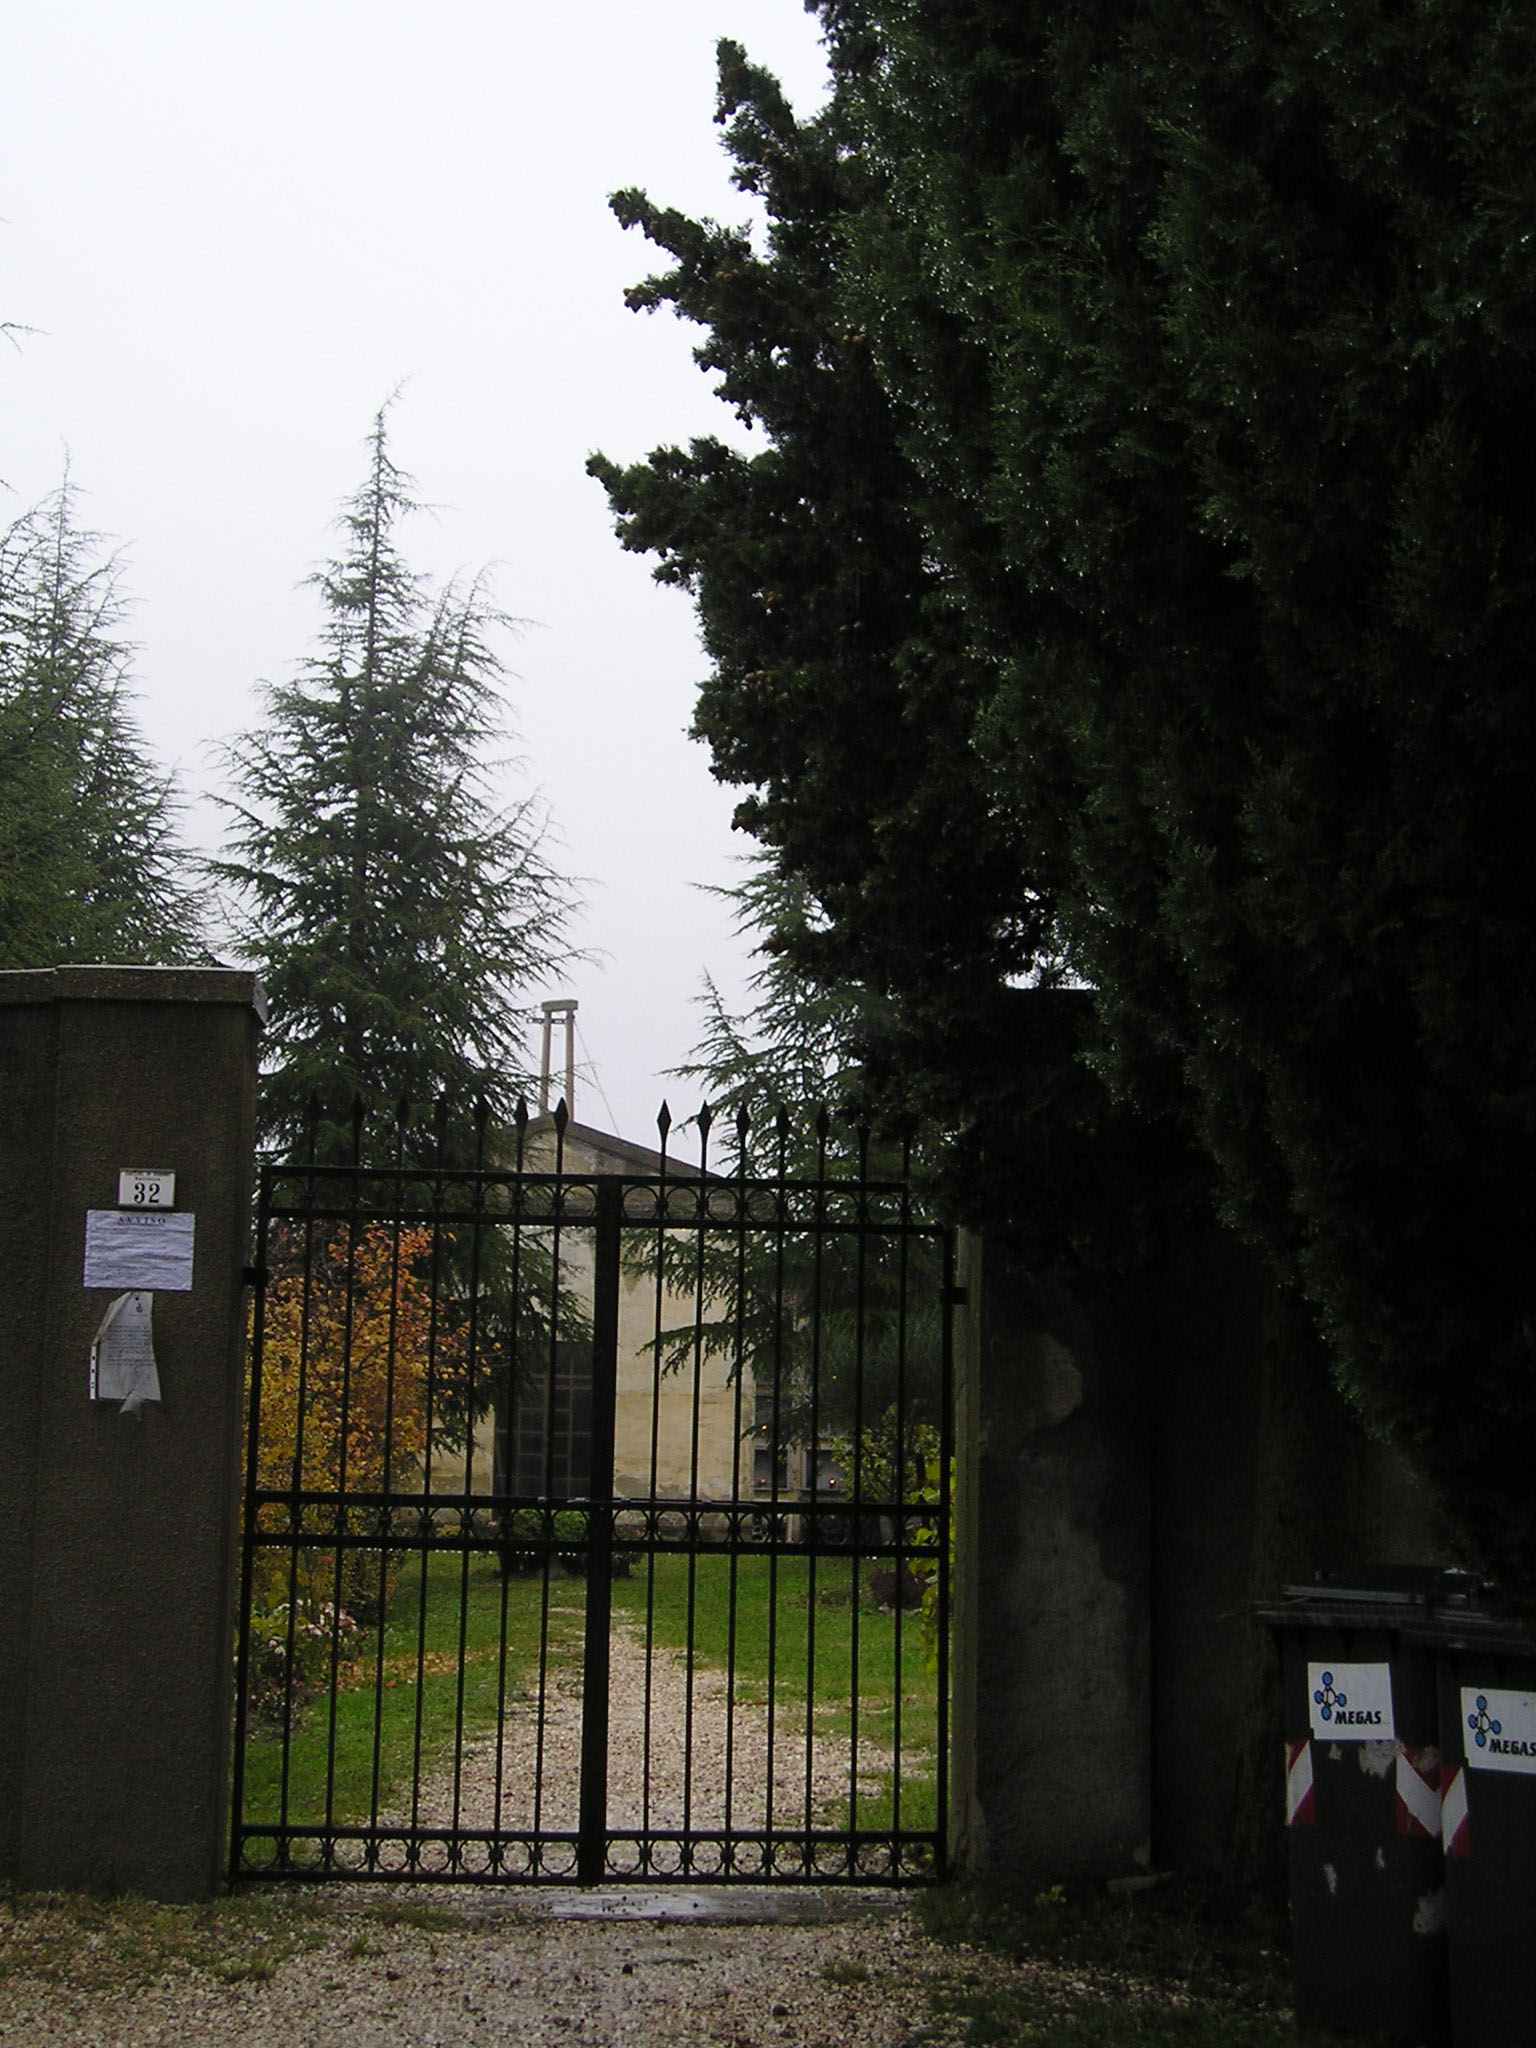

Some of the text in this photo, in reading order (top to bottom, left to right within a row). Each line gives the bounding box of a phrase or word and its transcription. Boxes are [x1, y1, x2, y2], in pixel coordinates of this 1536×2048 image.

[134, 1182, 160, 1204] 32
[117, 1215, 166, 1225] AVVISO
[1334, 1710, 1382, 1725] MEGAS
[1489, 1738, 1536, 1757] MEGAS
